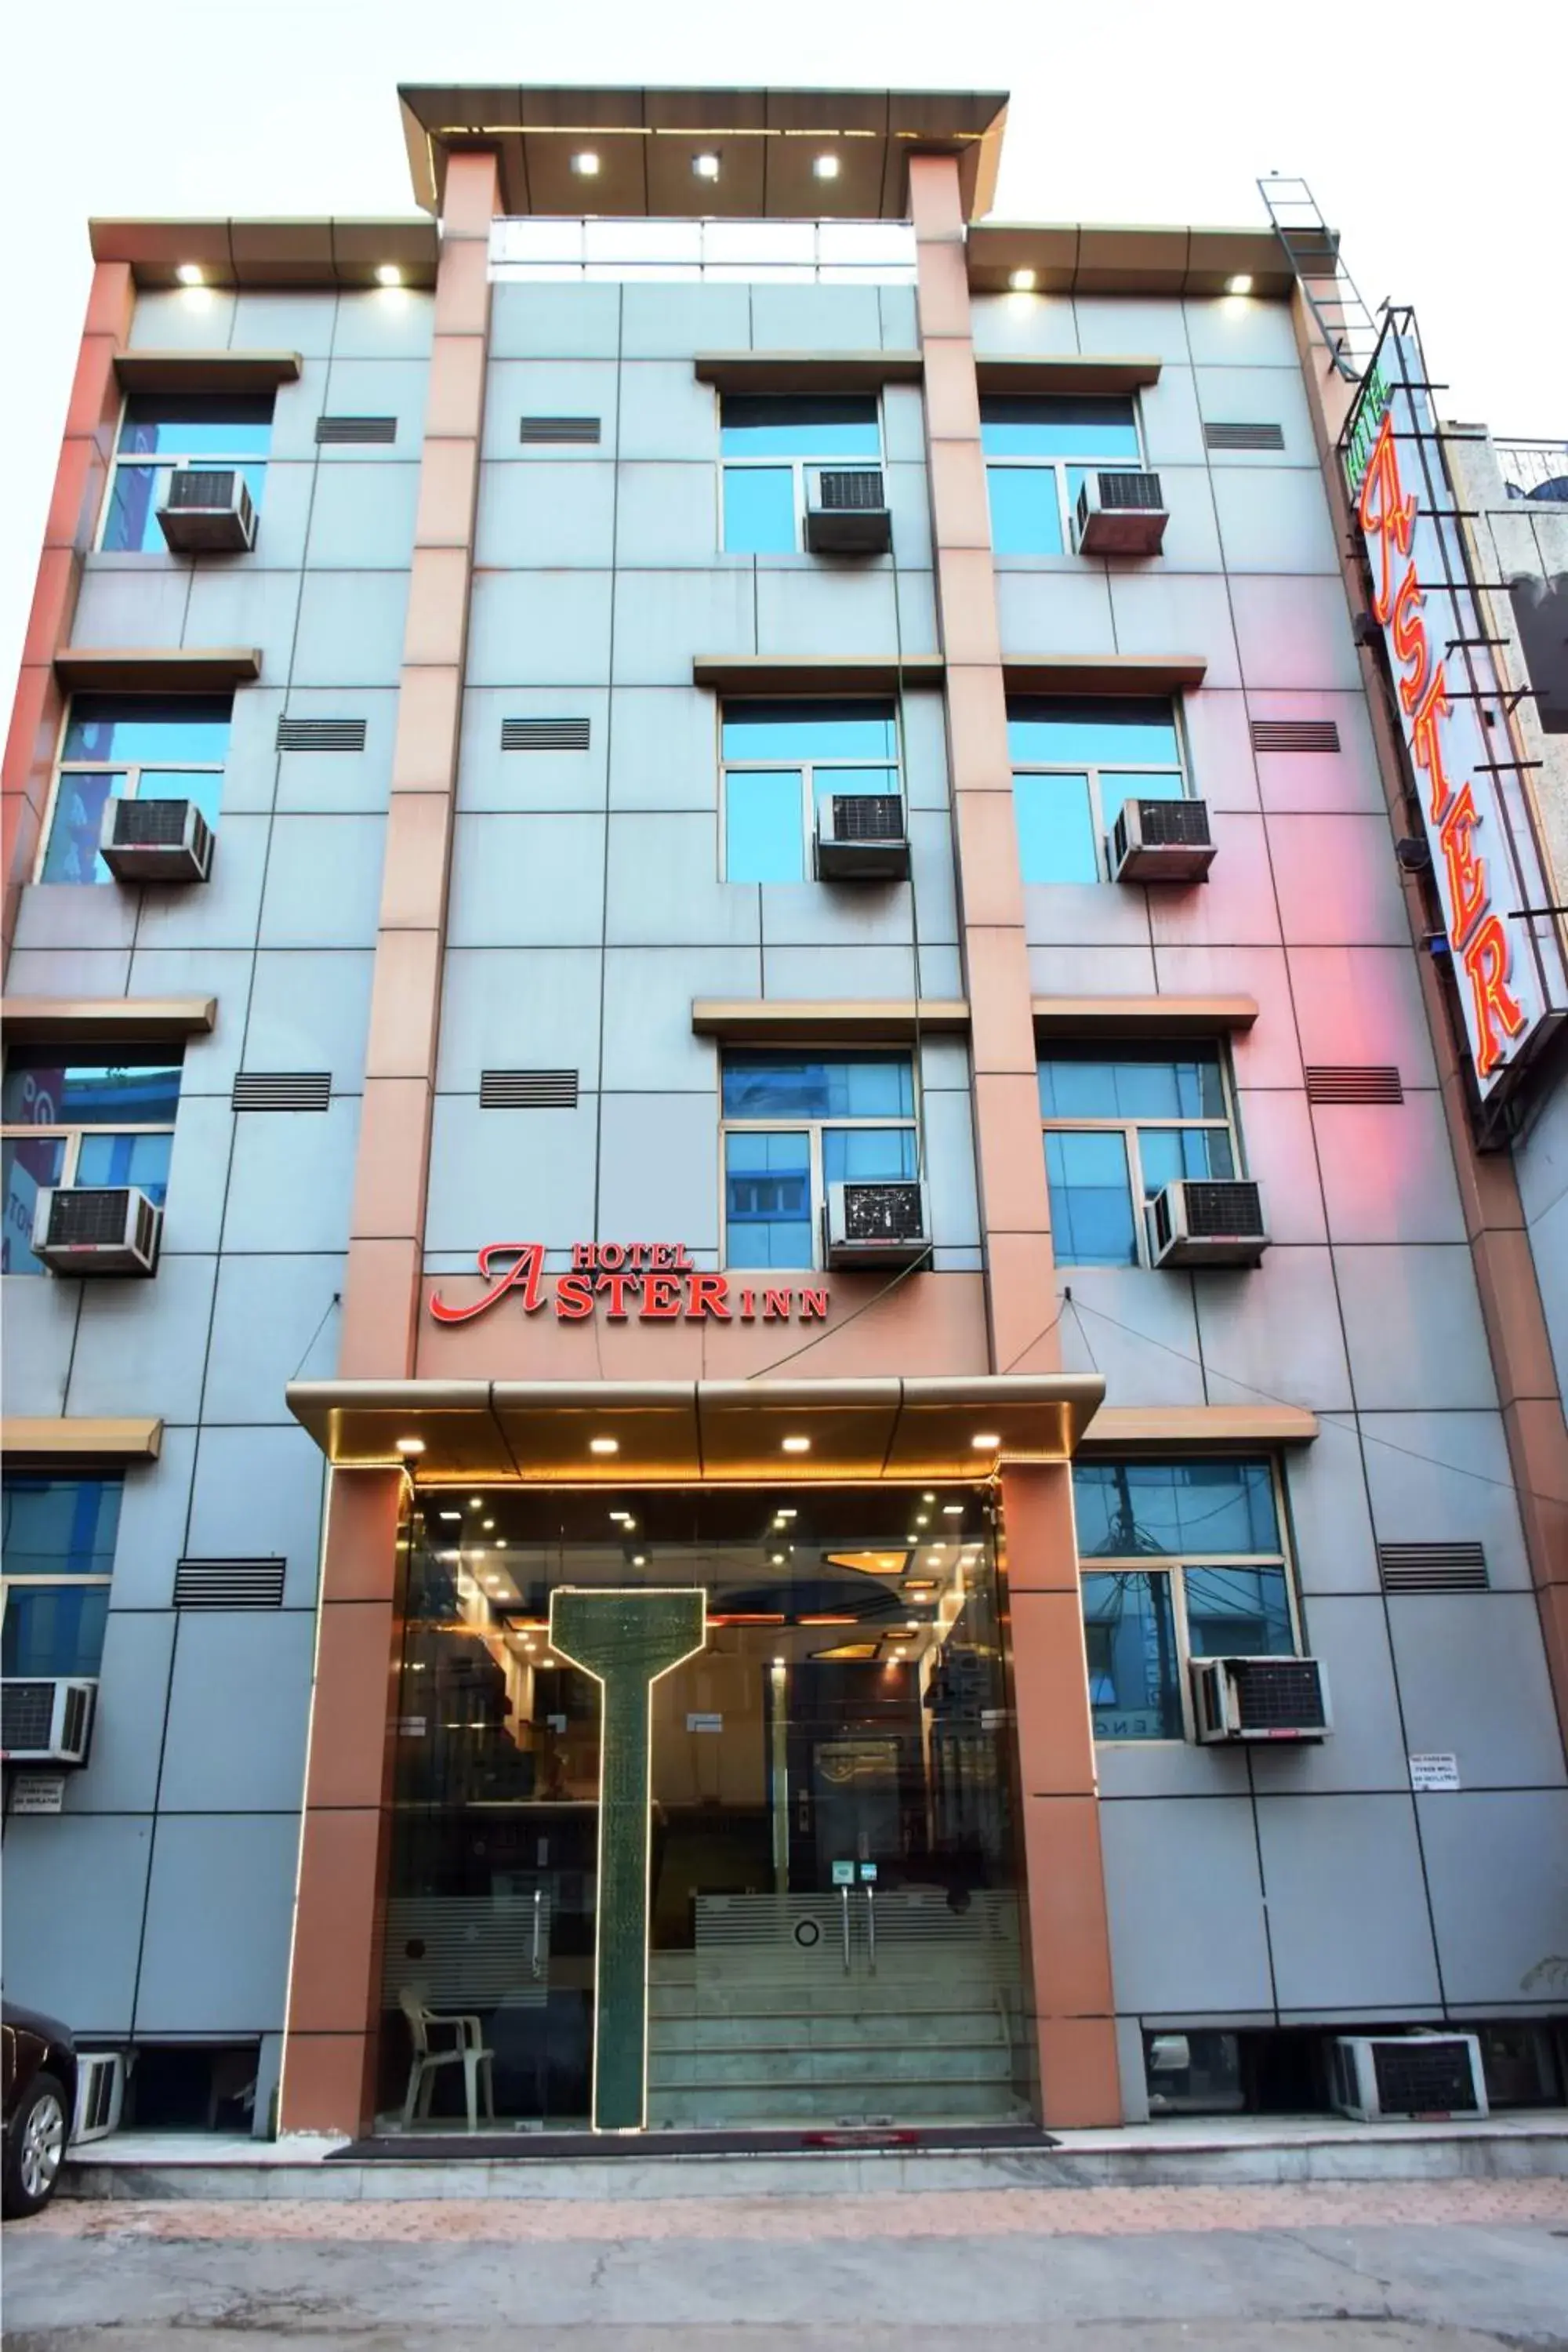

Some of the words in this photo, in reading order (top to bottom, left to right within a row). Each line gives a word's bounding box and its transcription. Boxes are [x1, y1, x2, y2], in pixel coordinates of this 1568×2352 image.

[1346, 367, 1390, 492] HOTEL
[1359, 408, 1526, 1079] ASTER
[430, 1243, 731, 1323] ASTER
[739, 1289, 829, 1319] INN
[572, 1242, 694, 1271] HOTEL
